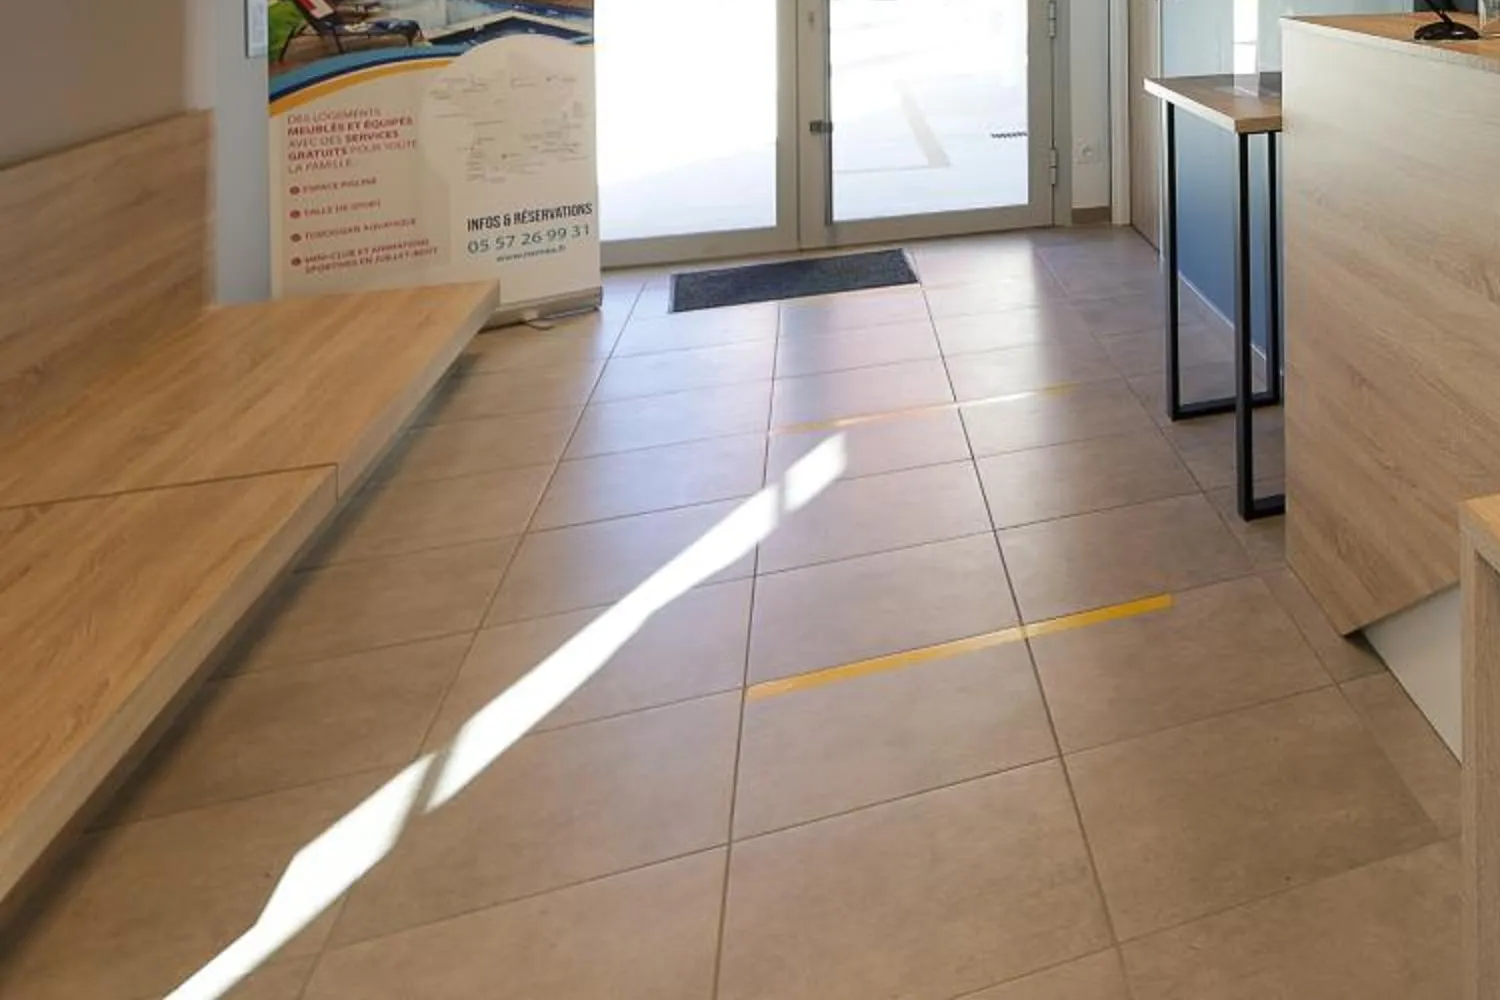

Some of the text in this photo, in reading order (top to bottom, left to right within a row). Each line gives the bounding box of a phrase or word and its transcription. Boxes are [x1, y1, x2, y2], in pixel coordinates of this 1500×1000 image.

[346, 130, 400, 143] SERVICES
[288, 147, 348, 161] GRATUITS
[467, 202, 594, 232] INFOS & RÉSERVATIONS
[467, 223, 590, 254] 05 57 26 99 31
